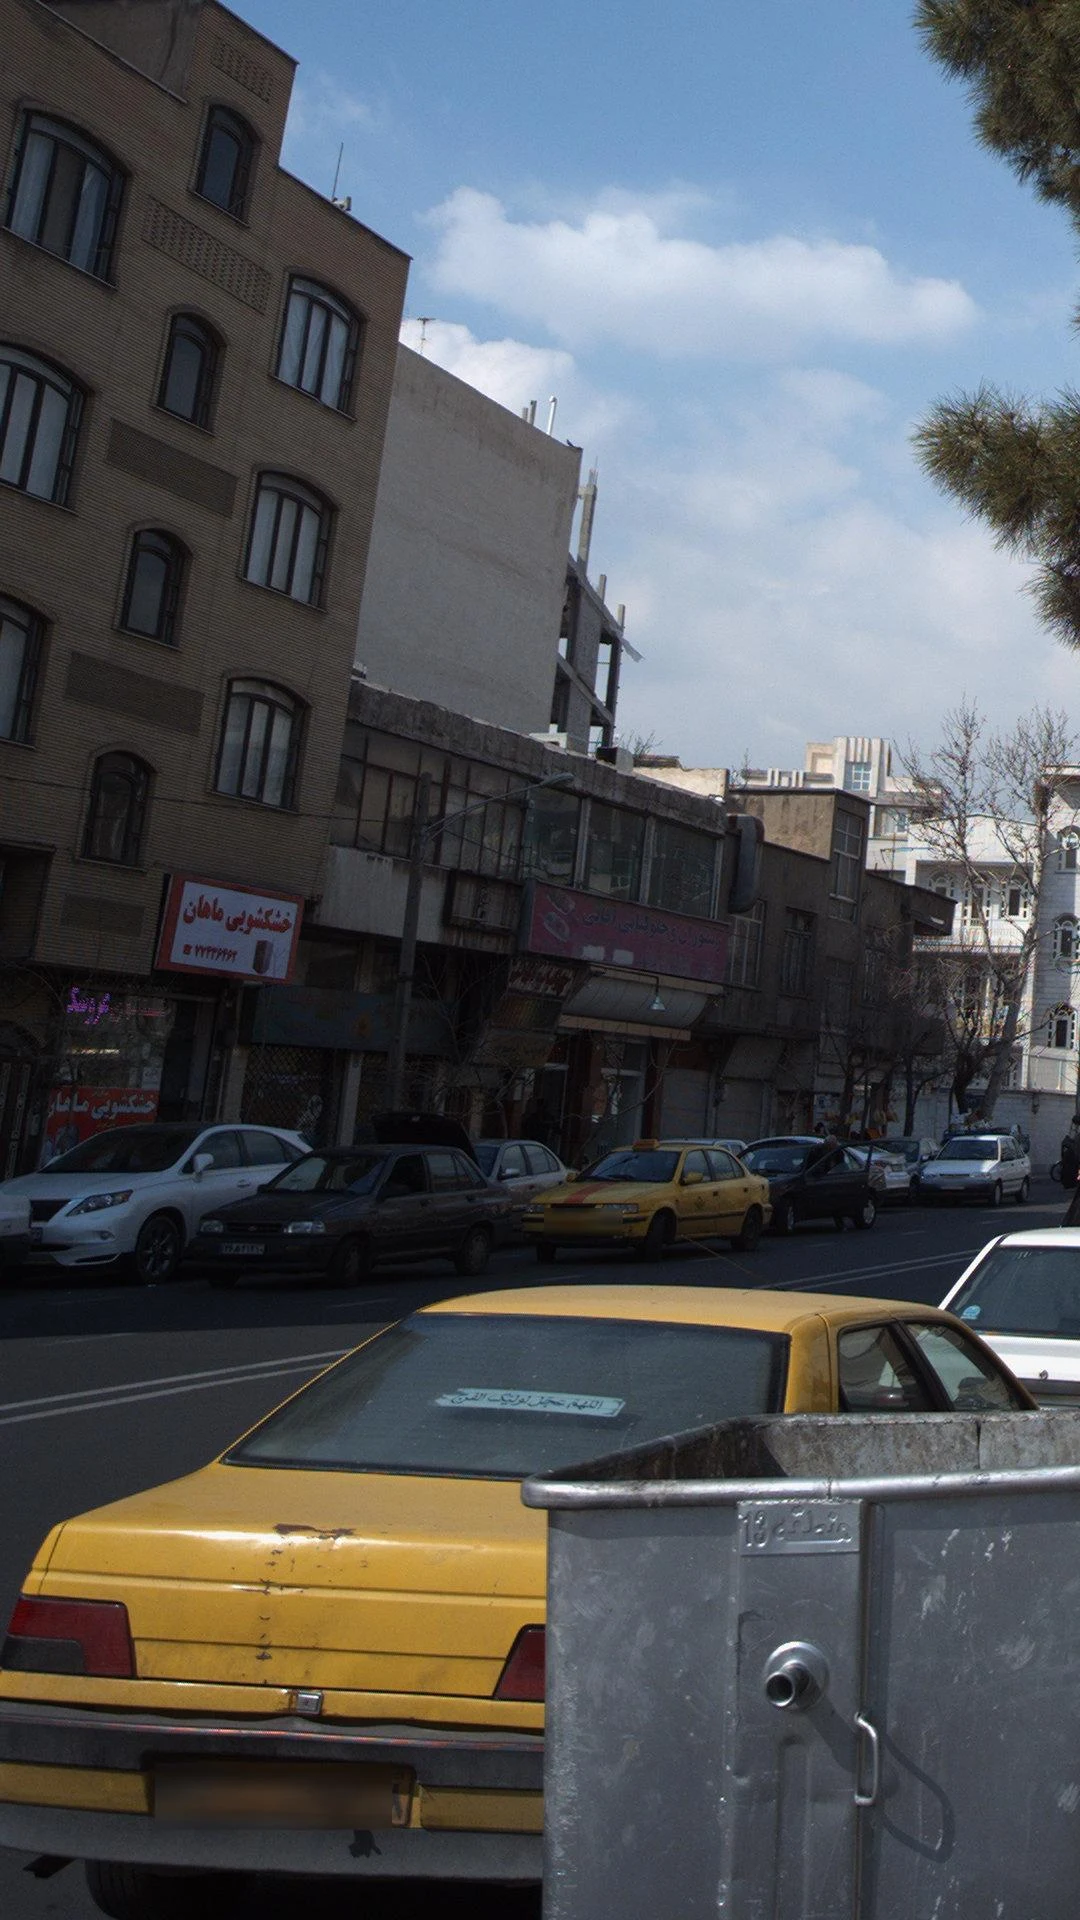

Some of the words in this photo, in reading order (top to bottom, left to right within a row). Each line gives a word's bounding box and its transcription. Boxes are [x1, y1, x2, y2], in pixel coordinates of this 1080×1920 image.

[183, 895, 224, 924] ماهان
[225, 907, 292, 935] خشکشویی
[91, 1093, 157, 1120] خشکشویی
[772, 1505, 854, 1544] منطقه
